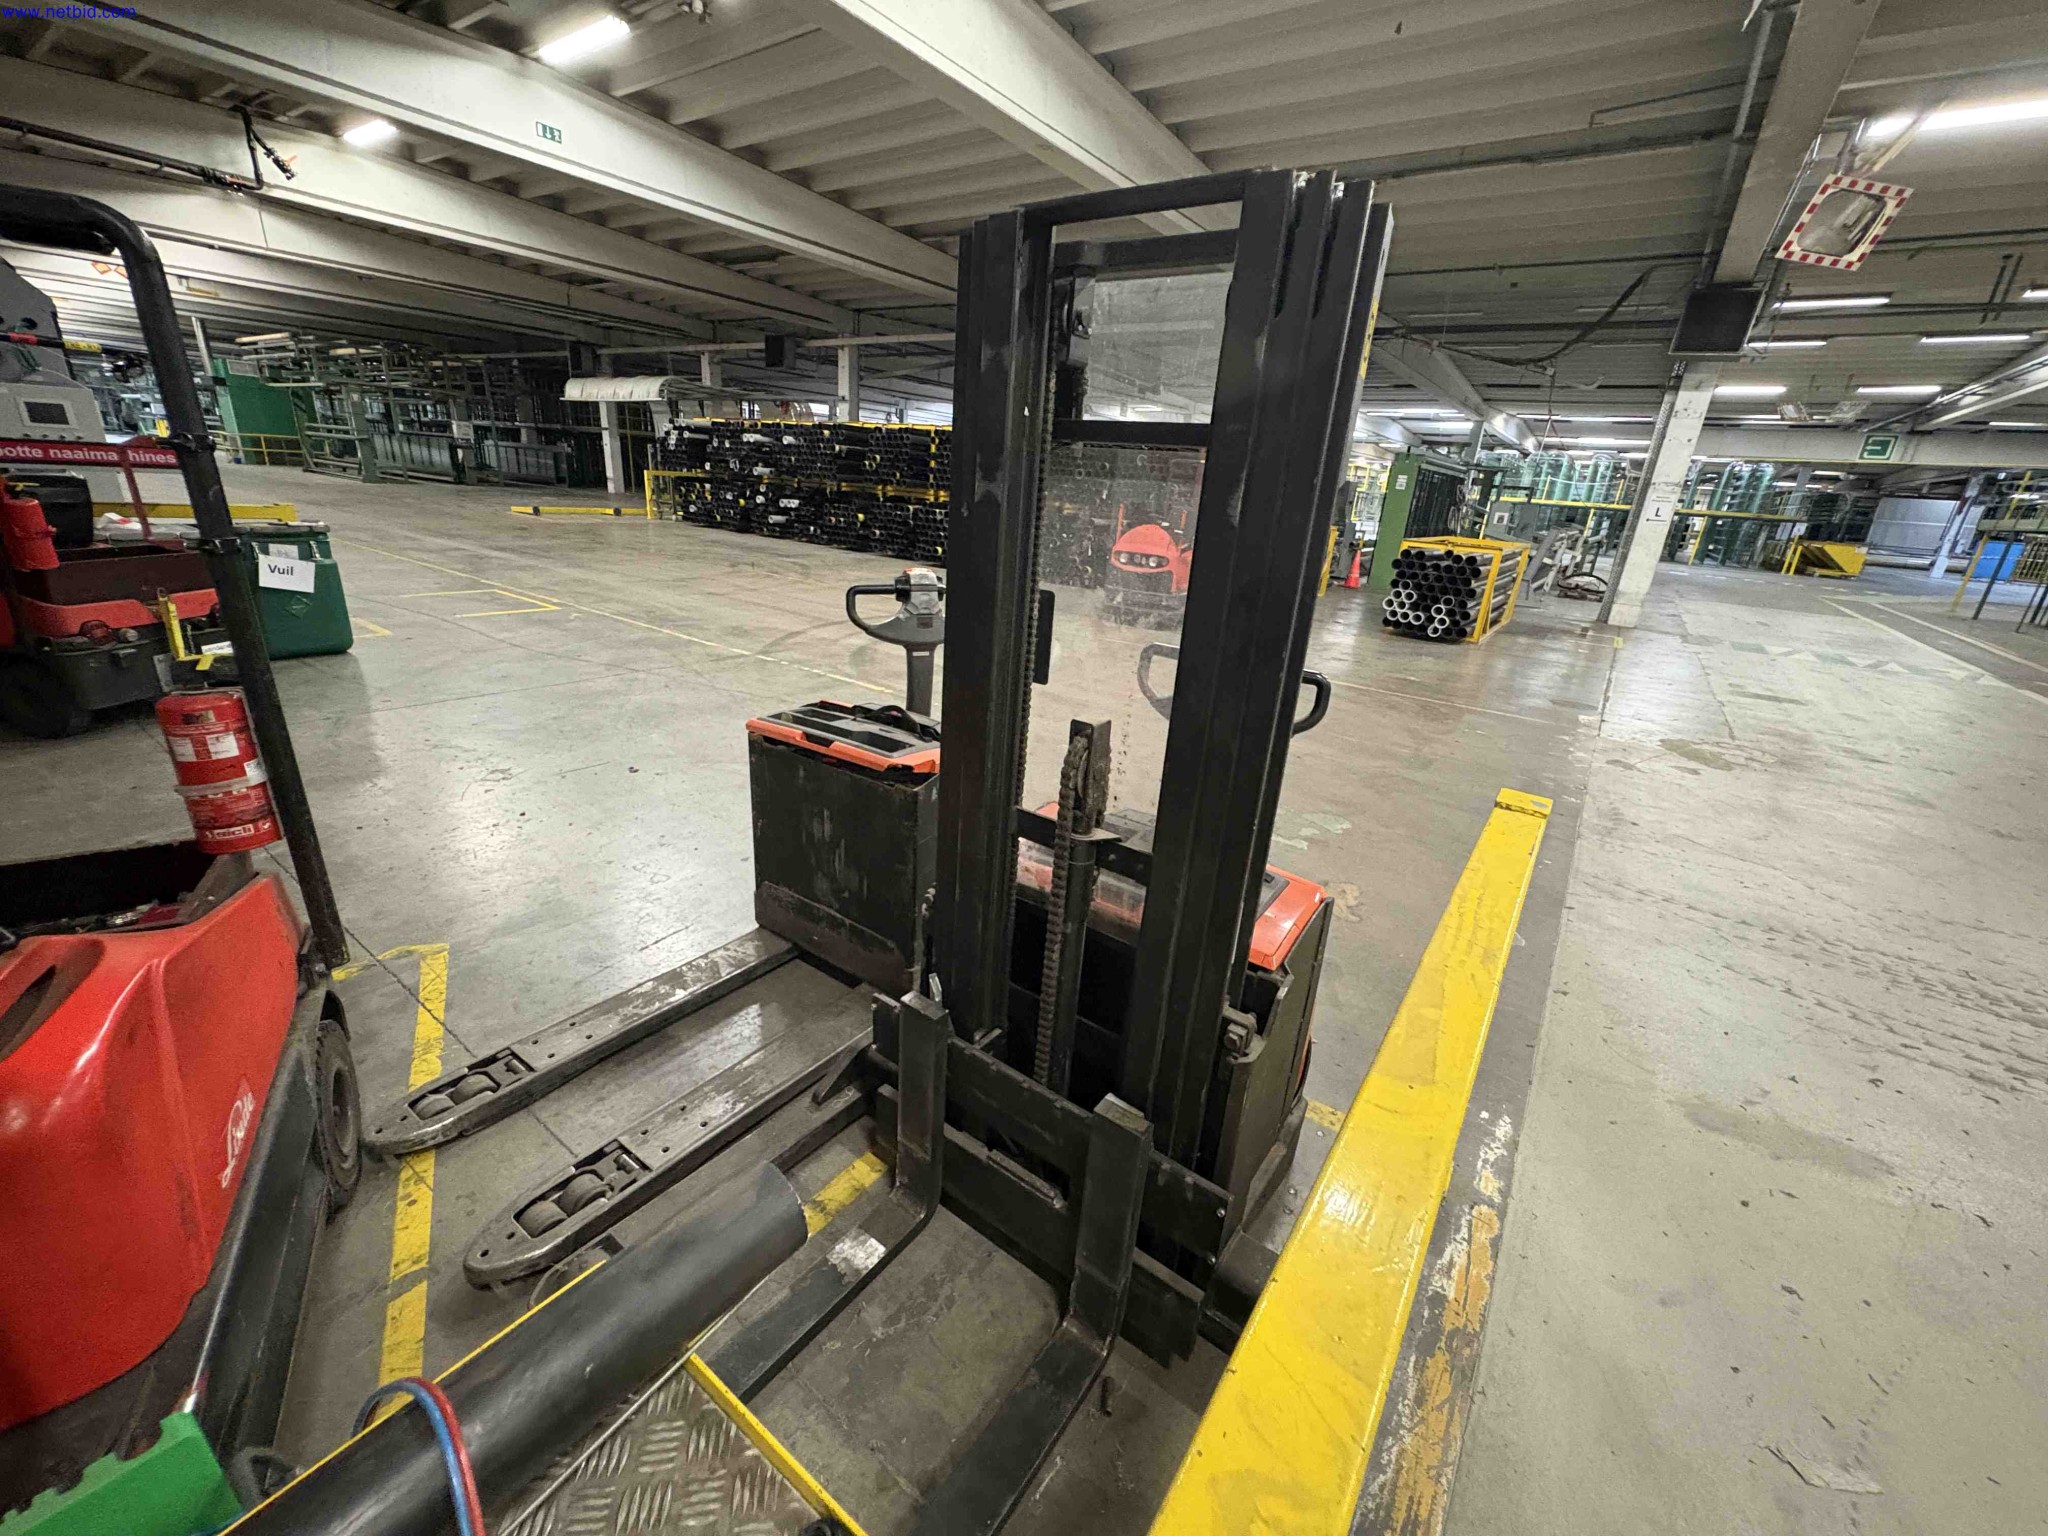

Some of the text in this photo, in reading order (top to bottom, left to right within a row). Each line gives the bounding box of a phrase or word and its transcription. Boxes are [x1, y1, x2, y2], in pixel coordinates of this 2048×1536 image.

[51, 449, 177, 464] naaimahines
[1655, 507, 1662, 517] L
[268, 564, 294, 576] Vuil
